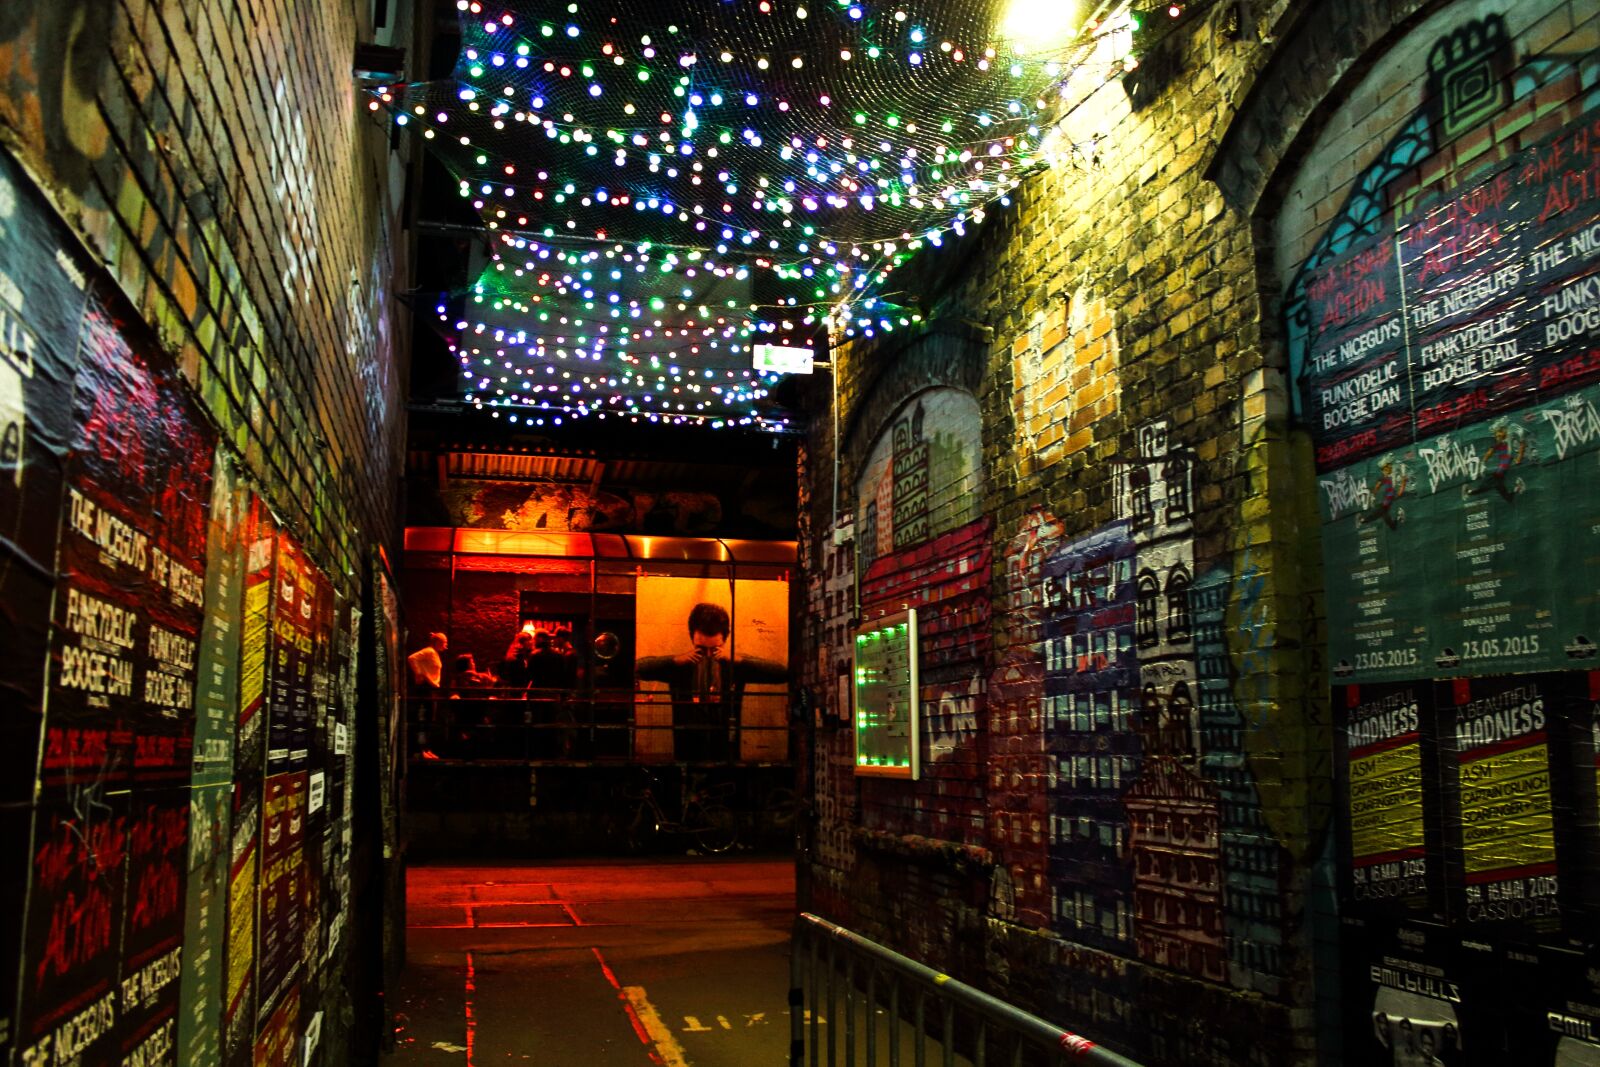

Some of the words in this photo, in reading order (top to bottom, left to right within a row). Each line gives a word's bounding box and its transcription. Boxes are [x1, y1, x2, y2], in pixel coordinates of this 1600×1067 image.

[1530, 244, 1564, 275] THE
[1411, 301, 1440, 326] THE
[1444, 263, 1520, 313] NICEGUYS
[1314, 349, 1337, 373] THE
[1340, 318, 1401, 362] NICEGUYS
[1421, 312, 1516, 366] FUNKYDELIC
[1322, 361, 1398, 408] FUNKYDELIC
[1423, 354, 1477, 391] BOOGIE
[1482, 340, 1518, 369] DAN
[1323, 397, 1368, 430] BOOGIE
[1371, 384, 1401, 411] DAN
[68, 488, 96, 541] THE
[96, 507, 148, 572] NICEGUYS
[65, 587, 137, 650] FUNKYDELIC
[1355, 649, 1417, 670] 23.05.2015
[1463, 635, 1540, 660] 23.05.2015
[107, 656, 133, 697] DAN
[1348, 703, 1420, 749] MADNESS
[1456, 700, 1546, 752] MADNESS
[1462, 762, 1492, 782] ASM
[1504, 775, 1548, 795] CRUNCH
[1529, 875, 1558, 897] 2015
[1466, 897, 1561, 923] CASSIOPEIA
